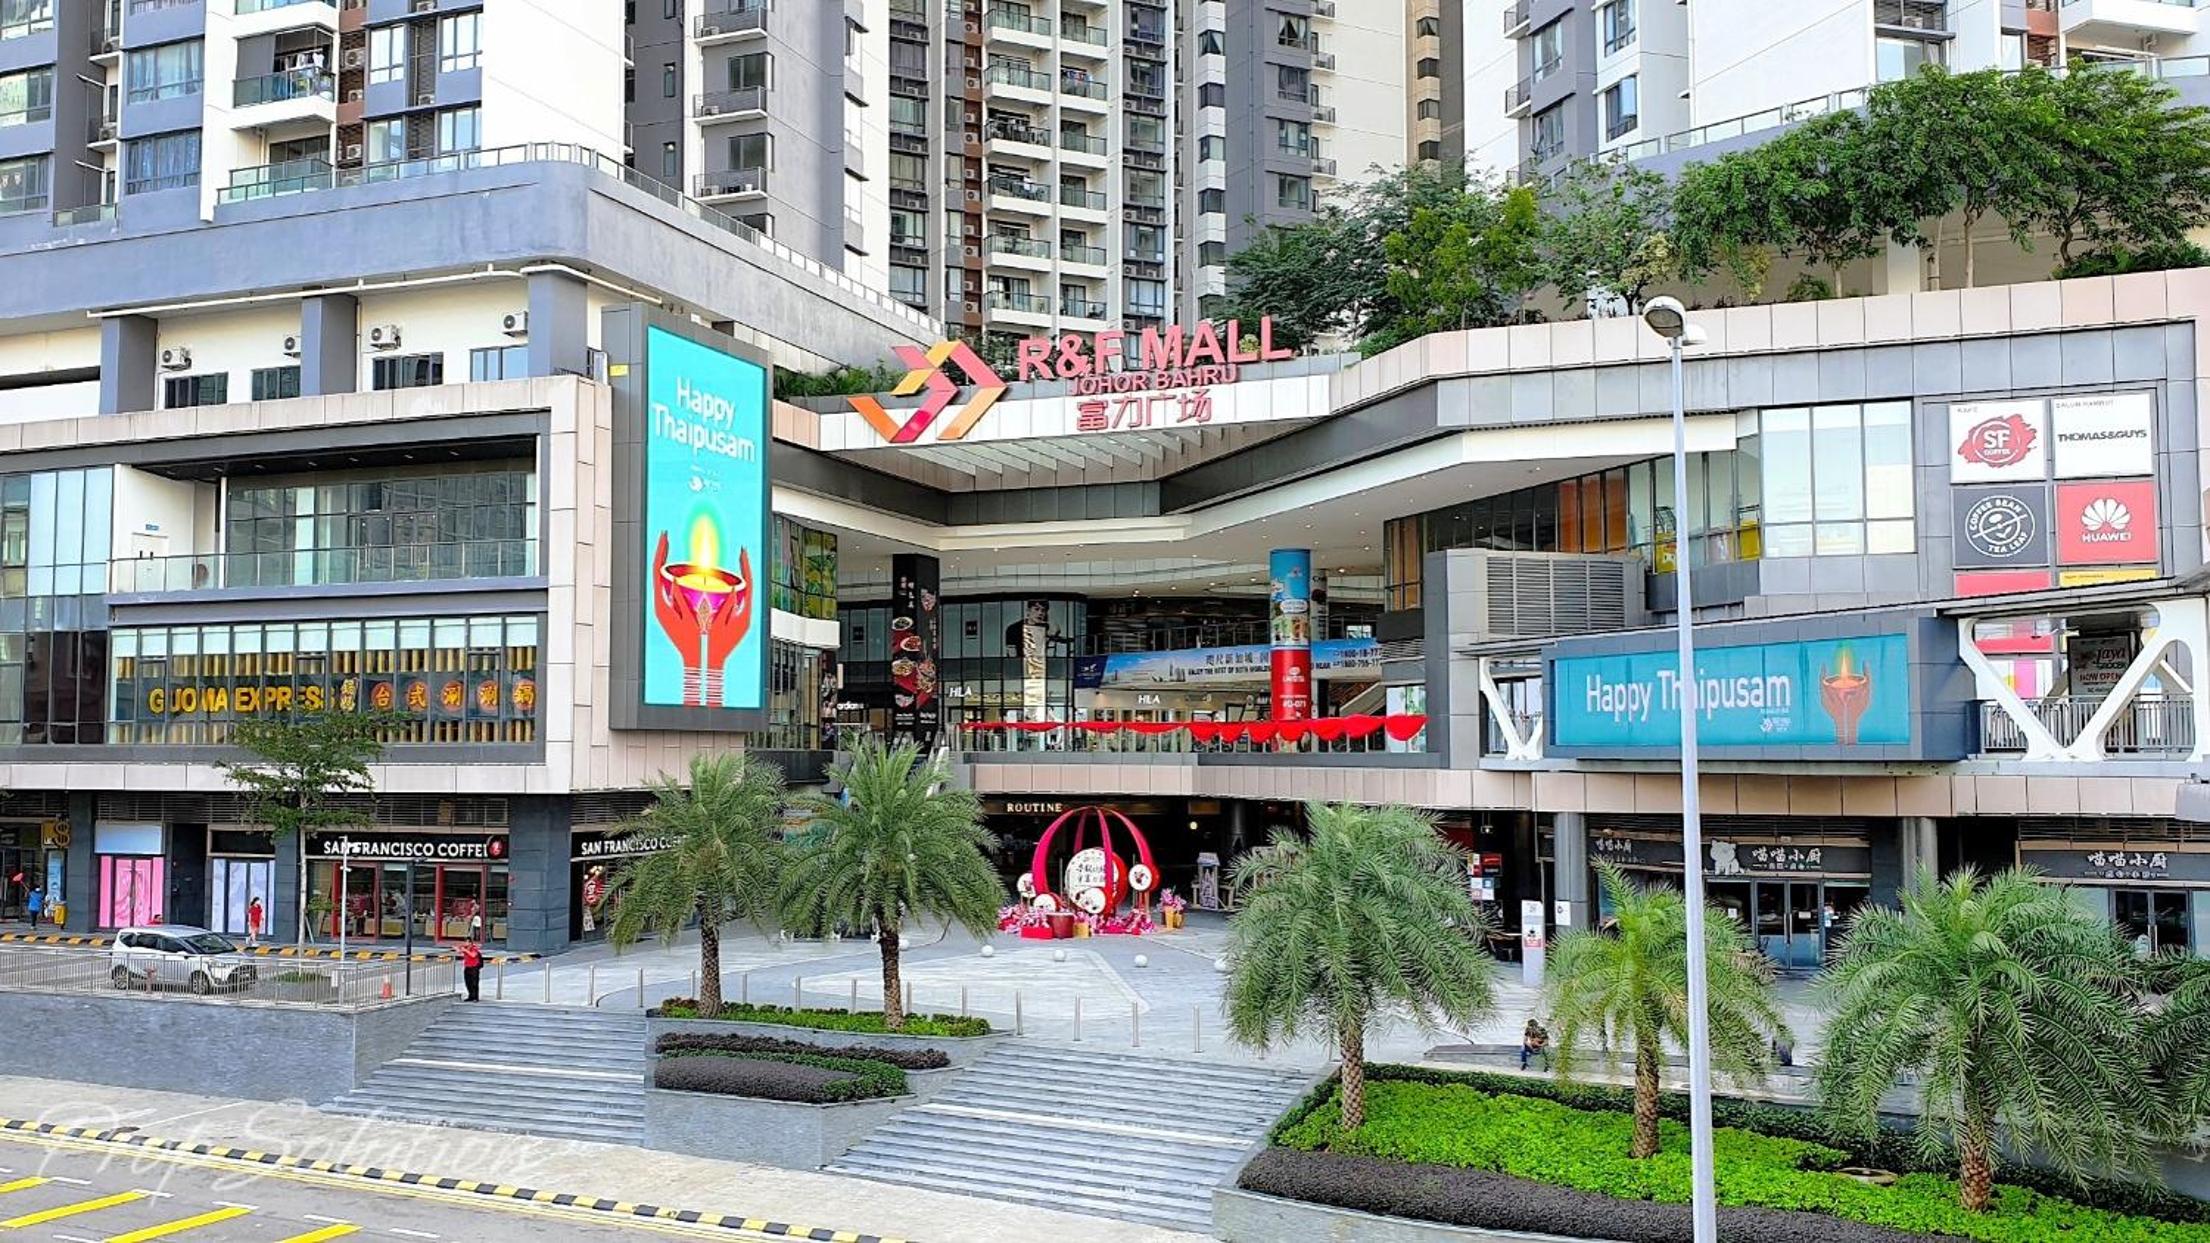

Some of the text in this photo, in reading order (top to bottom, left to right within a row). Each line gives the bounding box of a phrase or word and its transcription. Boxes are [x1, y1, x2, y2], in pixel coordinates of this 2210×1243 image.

[1018, 316, 1292, 382] R&F MALL
[1070, 364, 1238, 396] JOHOR BAHRU
[675, 376, 736, 431] Happy
[1077, 388, 1214, 431] 富力广场
[651, 401, 757, 463] Thaipusam
[1984, 429, 2010, 449] SF
[2057, 429, 2148, 442] THOMAS&GUYS
[1969, 499, 2022, 531] COFFEE BEAN
[1988, 531, 2029, 553] TEA LEAF
[2081, 532, 2132, 543] HUAWEI
[949, 686, 973, 697] HLA
[1138, 694, 1161, 704] HLA
[1586, 668, 1791, 722] Happy Thipusam
[1006, 803, 1062, 812] ROUTINE
[324, 841, 350, 854] SAN
[352, 842, 434, 857] FRANCISCO
[582, 841, 602, 855] SAN
